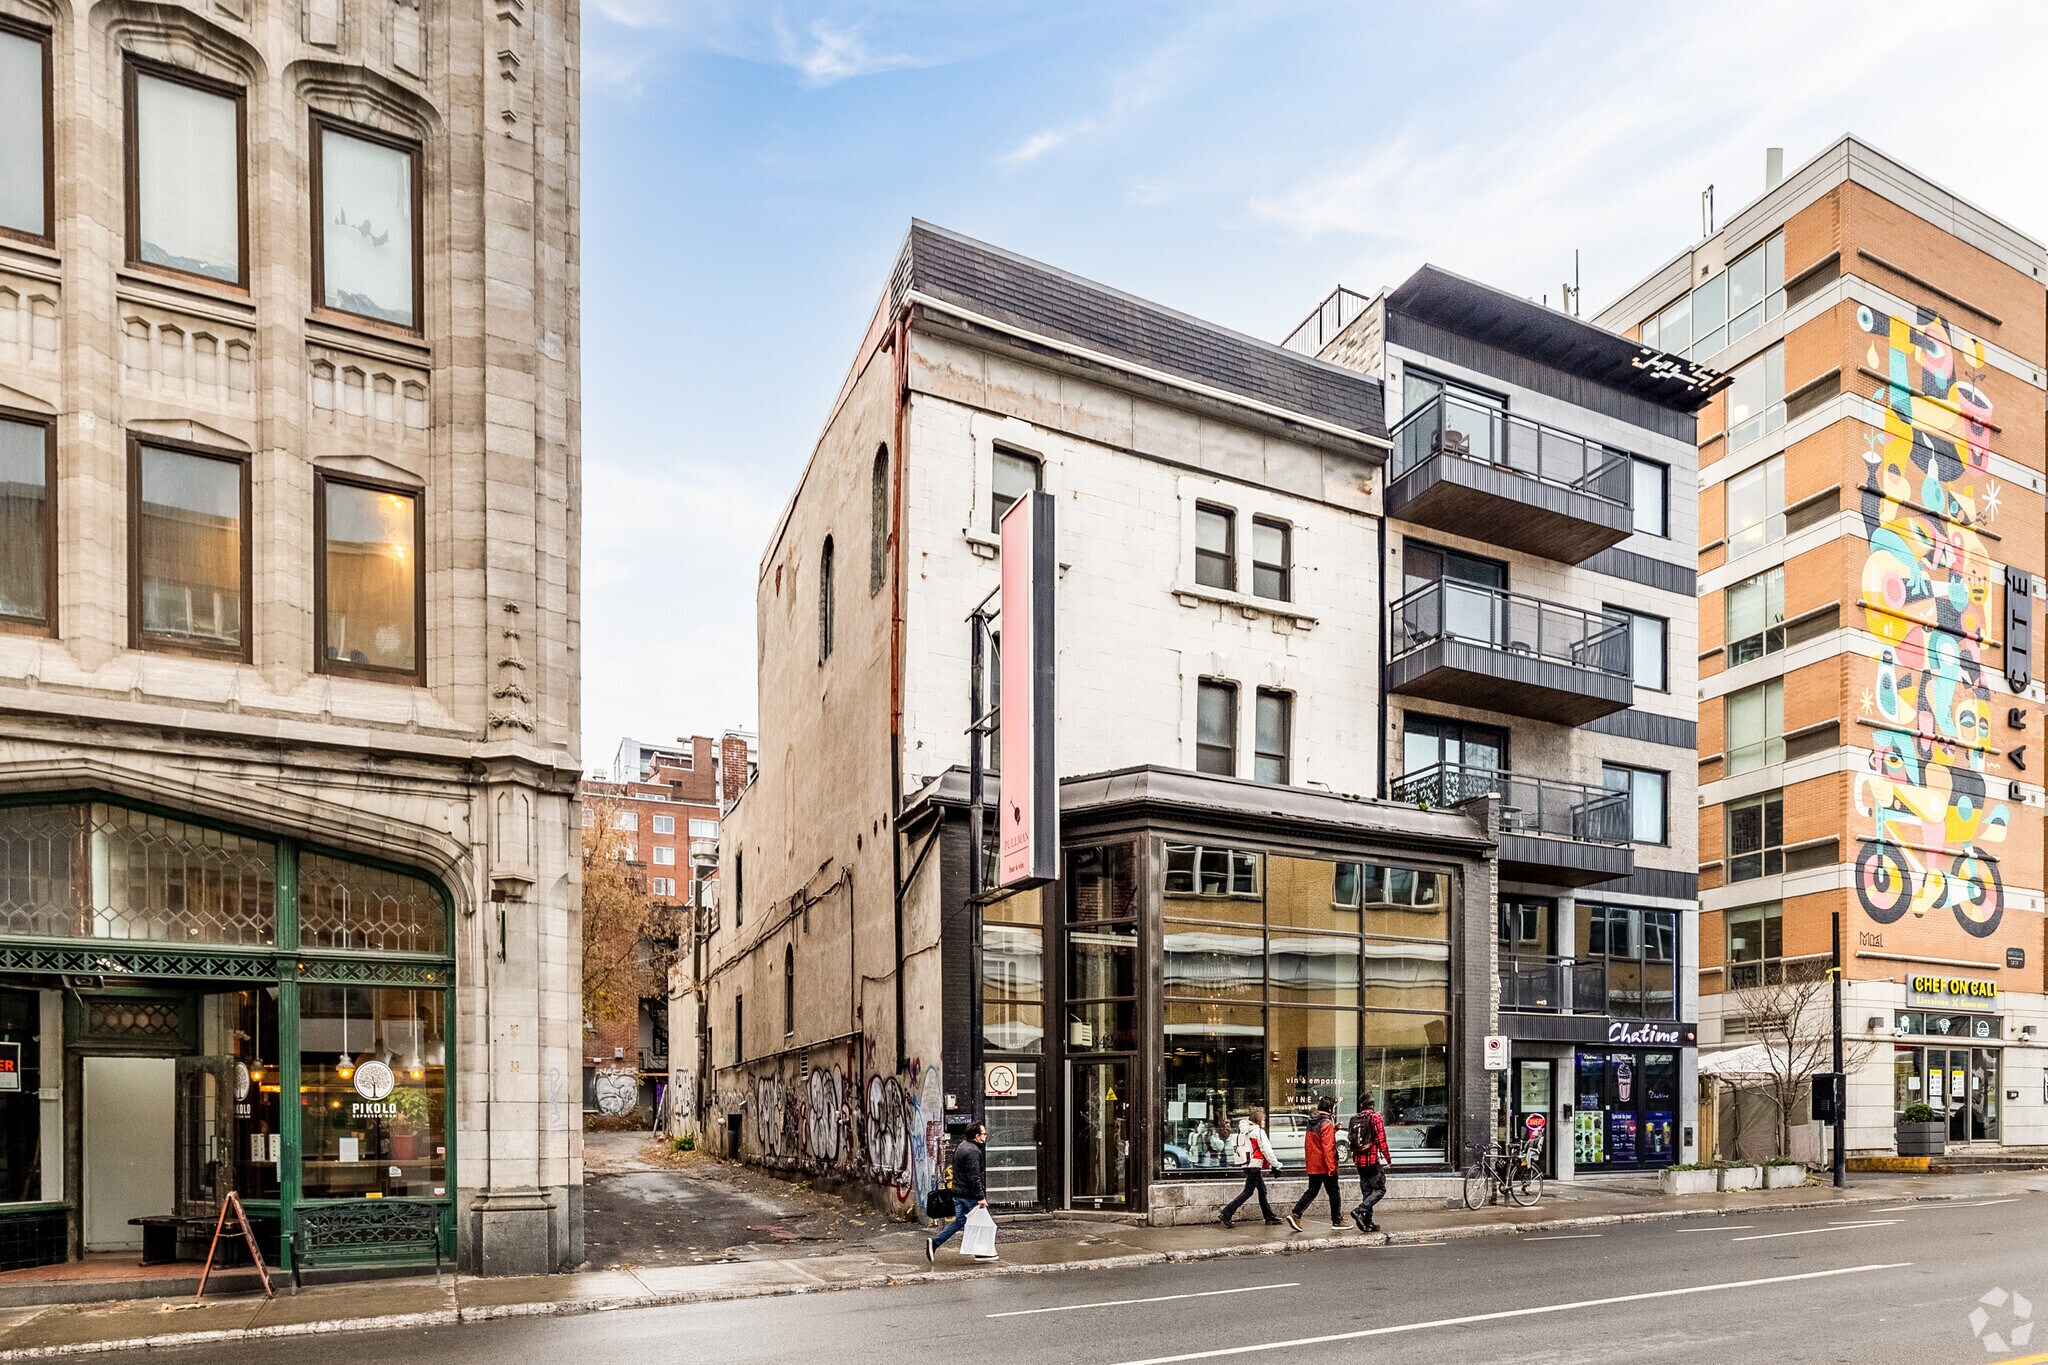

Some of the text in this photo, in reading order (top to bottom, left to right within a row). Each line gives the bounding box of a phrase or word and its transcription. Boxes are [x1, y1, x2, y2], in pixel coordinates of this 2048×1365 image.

[1914, 977, 2000, 998] CHEF ON CALL
[1608, 1022, 1679, 1044] Chatime
[1309, 1077, 1346, 1086] emporter
[235, 1103, 251, 1114] KOLO
[352, 1103, 397, 1114] PIKOLO
